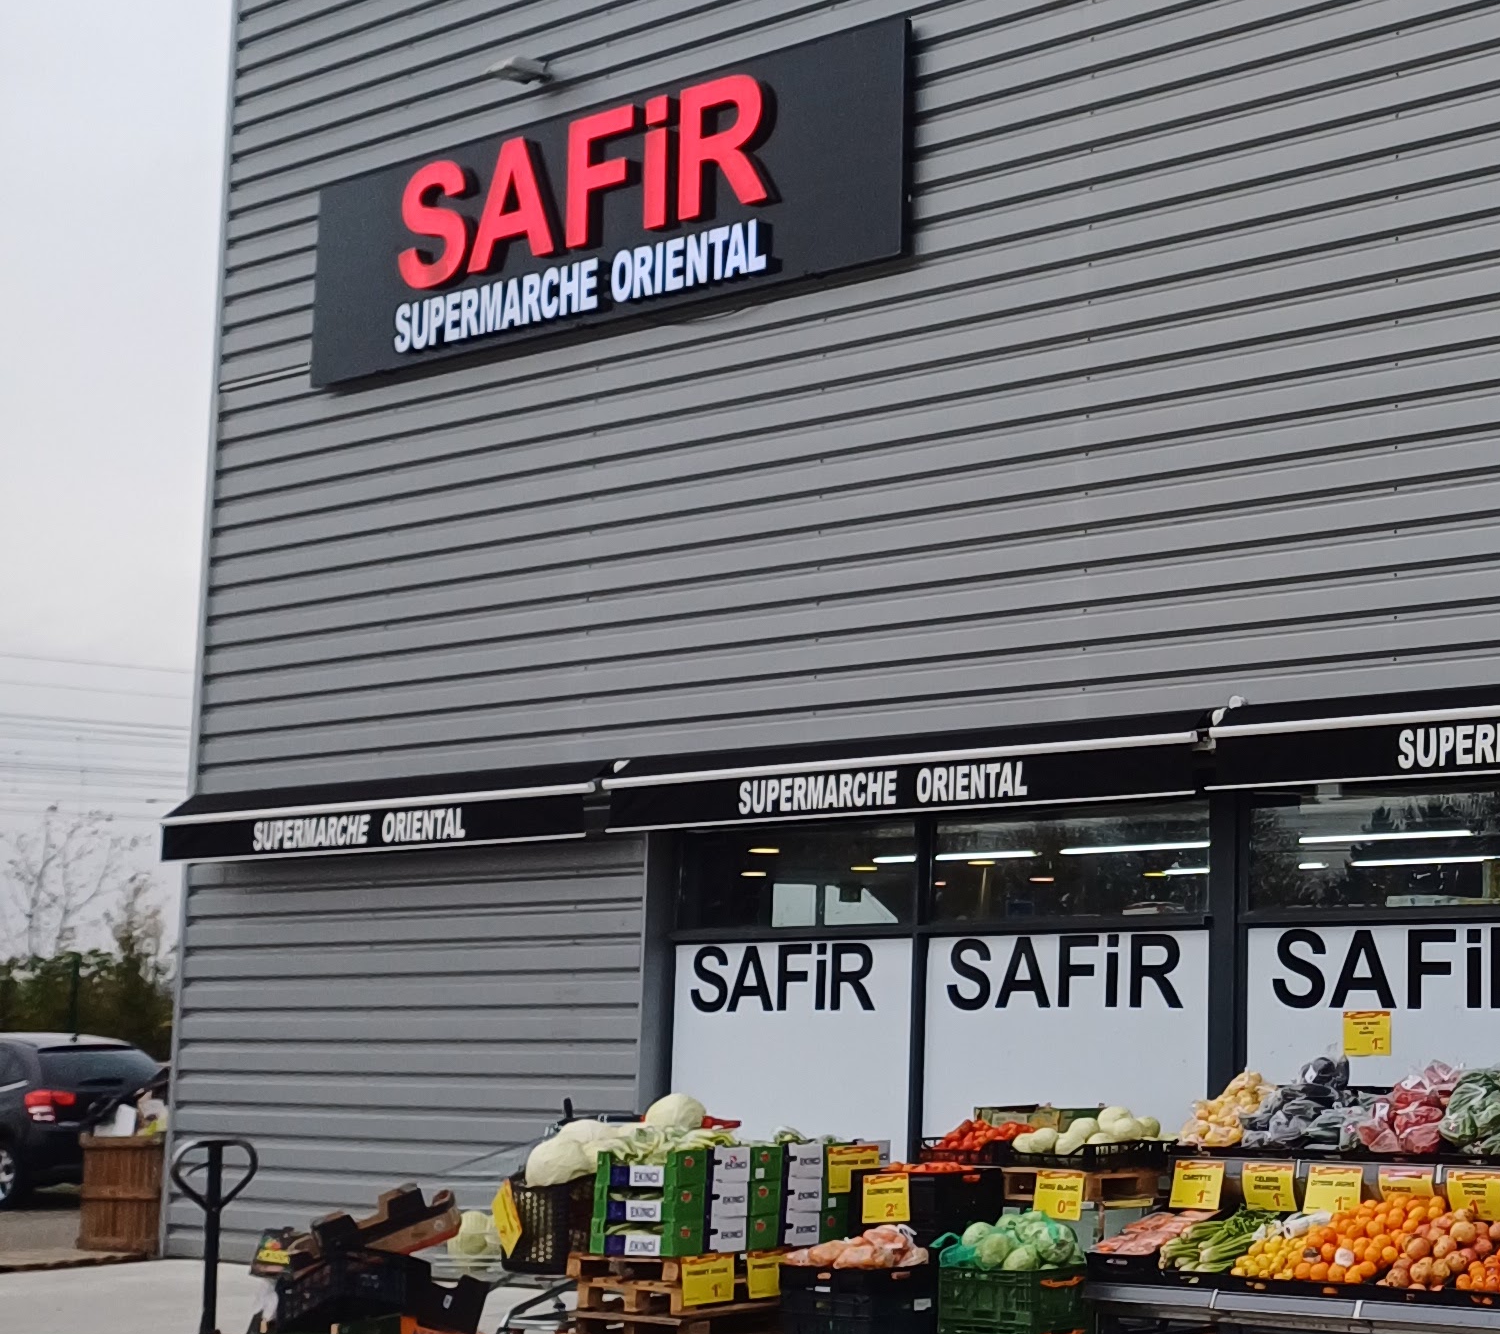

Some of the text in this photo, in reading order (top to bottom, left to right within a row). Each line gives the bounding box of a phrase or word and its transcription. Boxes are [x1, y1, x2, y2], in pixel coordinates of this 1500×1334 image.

[394, 218, 766, 354] SUPERMARCHE ORIENTAL
[738, 760, 1029, 816] SUPERMARCHE ORIENTAL
[252, 807, 467, 852] SUPERMARCHE ORIENTAL
